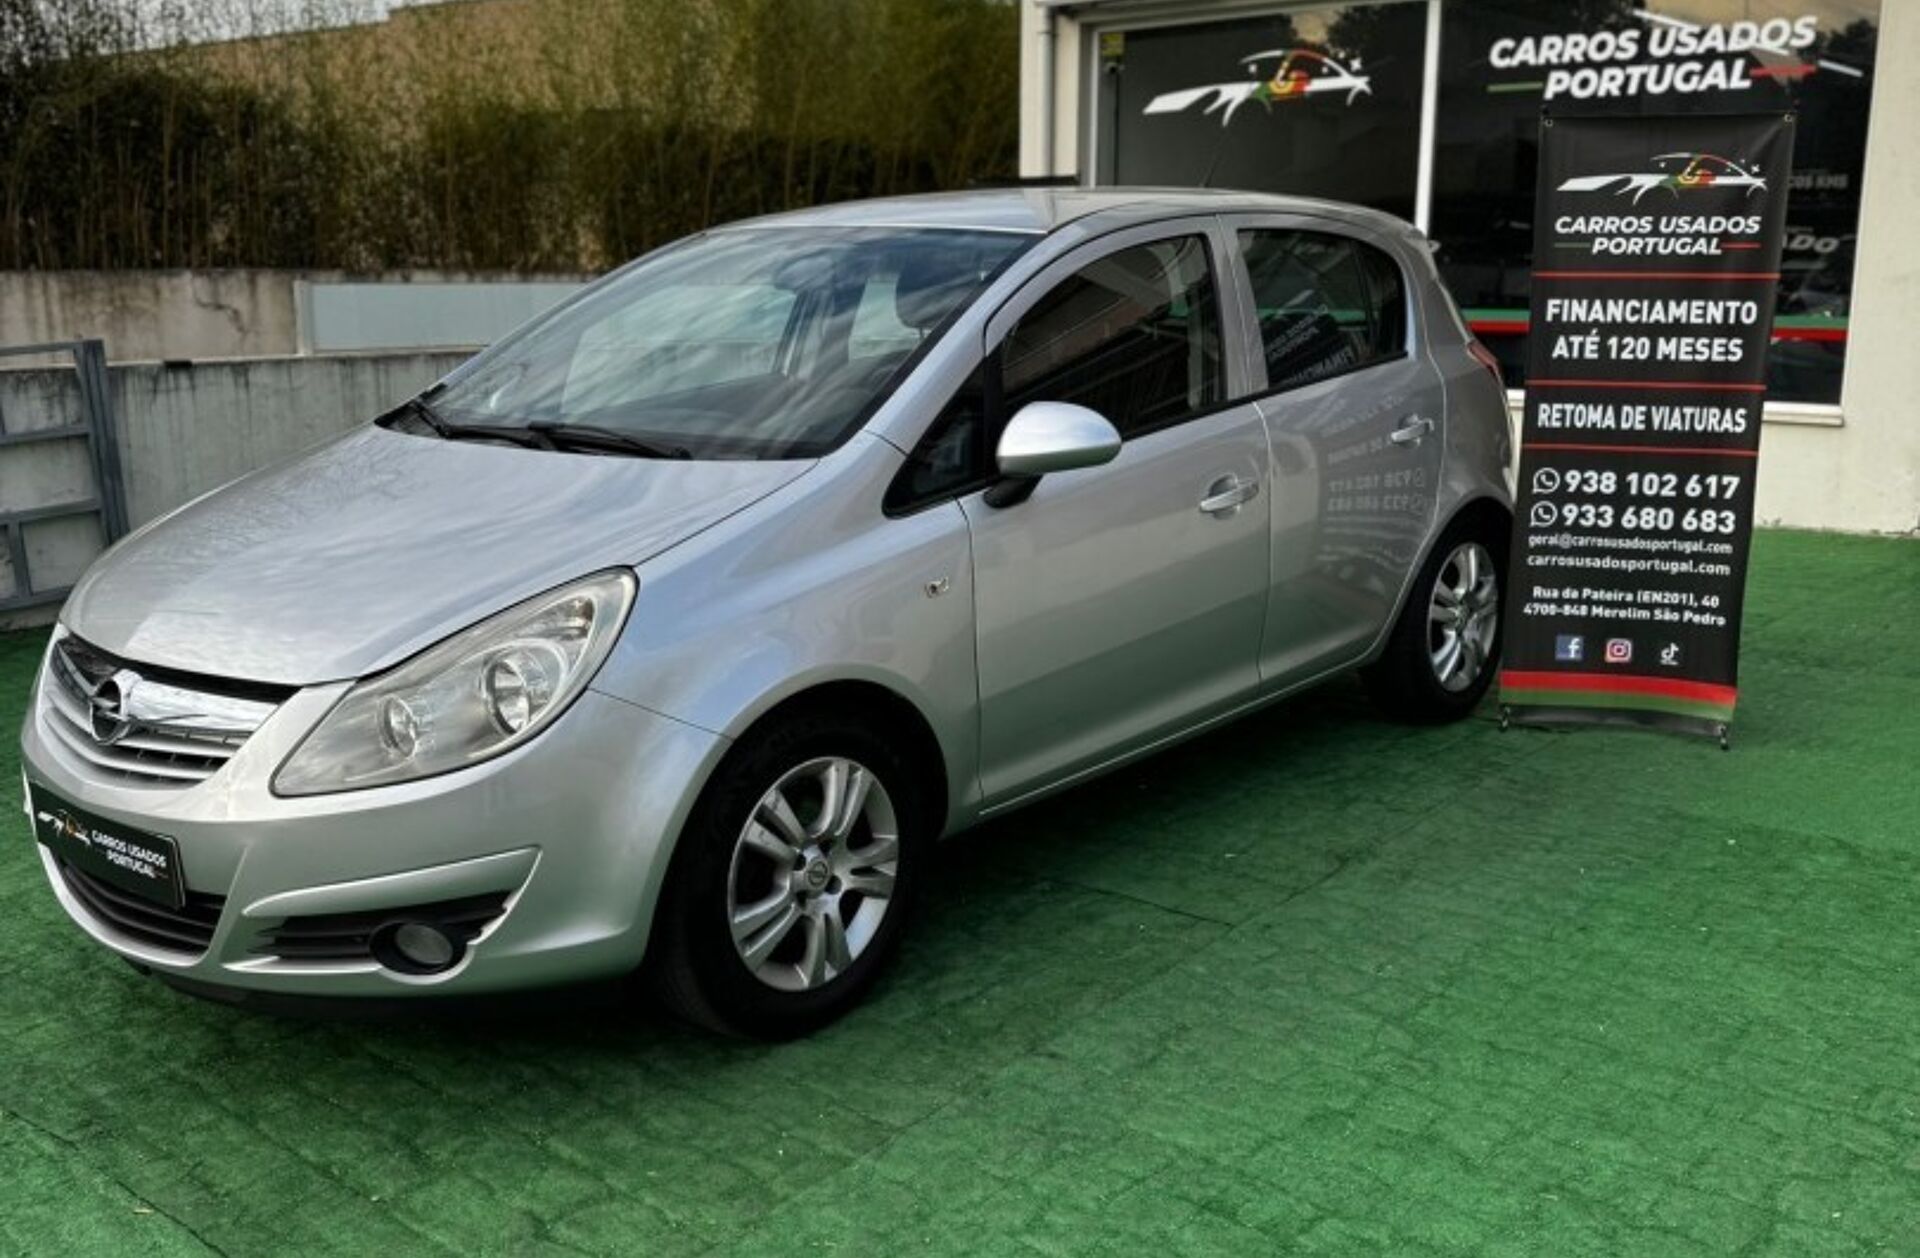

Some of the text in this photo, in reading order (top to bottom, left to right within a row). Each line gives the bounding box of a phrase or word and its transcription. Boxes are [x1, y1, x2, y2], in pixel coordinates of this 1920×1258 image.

[1489, 16, 1817, 67] CARROS USADOS
[1543, 59, 1752, 99] PORTUGAL
[1555, 216, 1761, 233] CARROS USADOS
[1592, 237, 1721, 254] PORTUGAL
[1546, 299, 1757, 324] FINANCIAMENTO
[1552, 328, 1742, 361] ATÉ 120 MESES
[1538, 404, 1747, 433] RETOMA DE VIATURAS
[1565, 470, 1740, 499] 938 102 617
[1562, 504, 1735, 533] 933 680 683
[1528, 534, 1733, 554] geral@carrosusadosportugal.com
[1527, 555, 1730, 575] carrosusadosportugal.com
[1533, 586, 1559, 598] Rua
[1654, 608, 1680, 621] São
[1683, 610, 1726, 626] Pedro
[92, 830, 168, 868] CARROS USADOS
[106, 849, 155, 878] PORTUGAL
